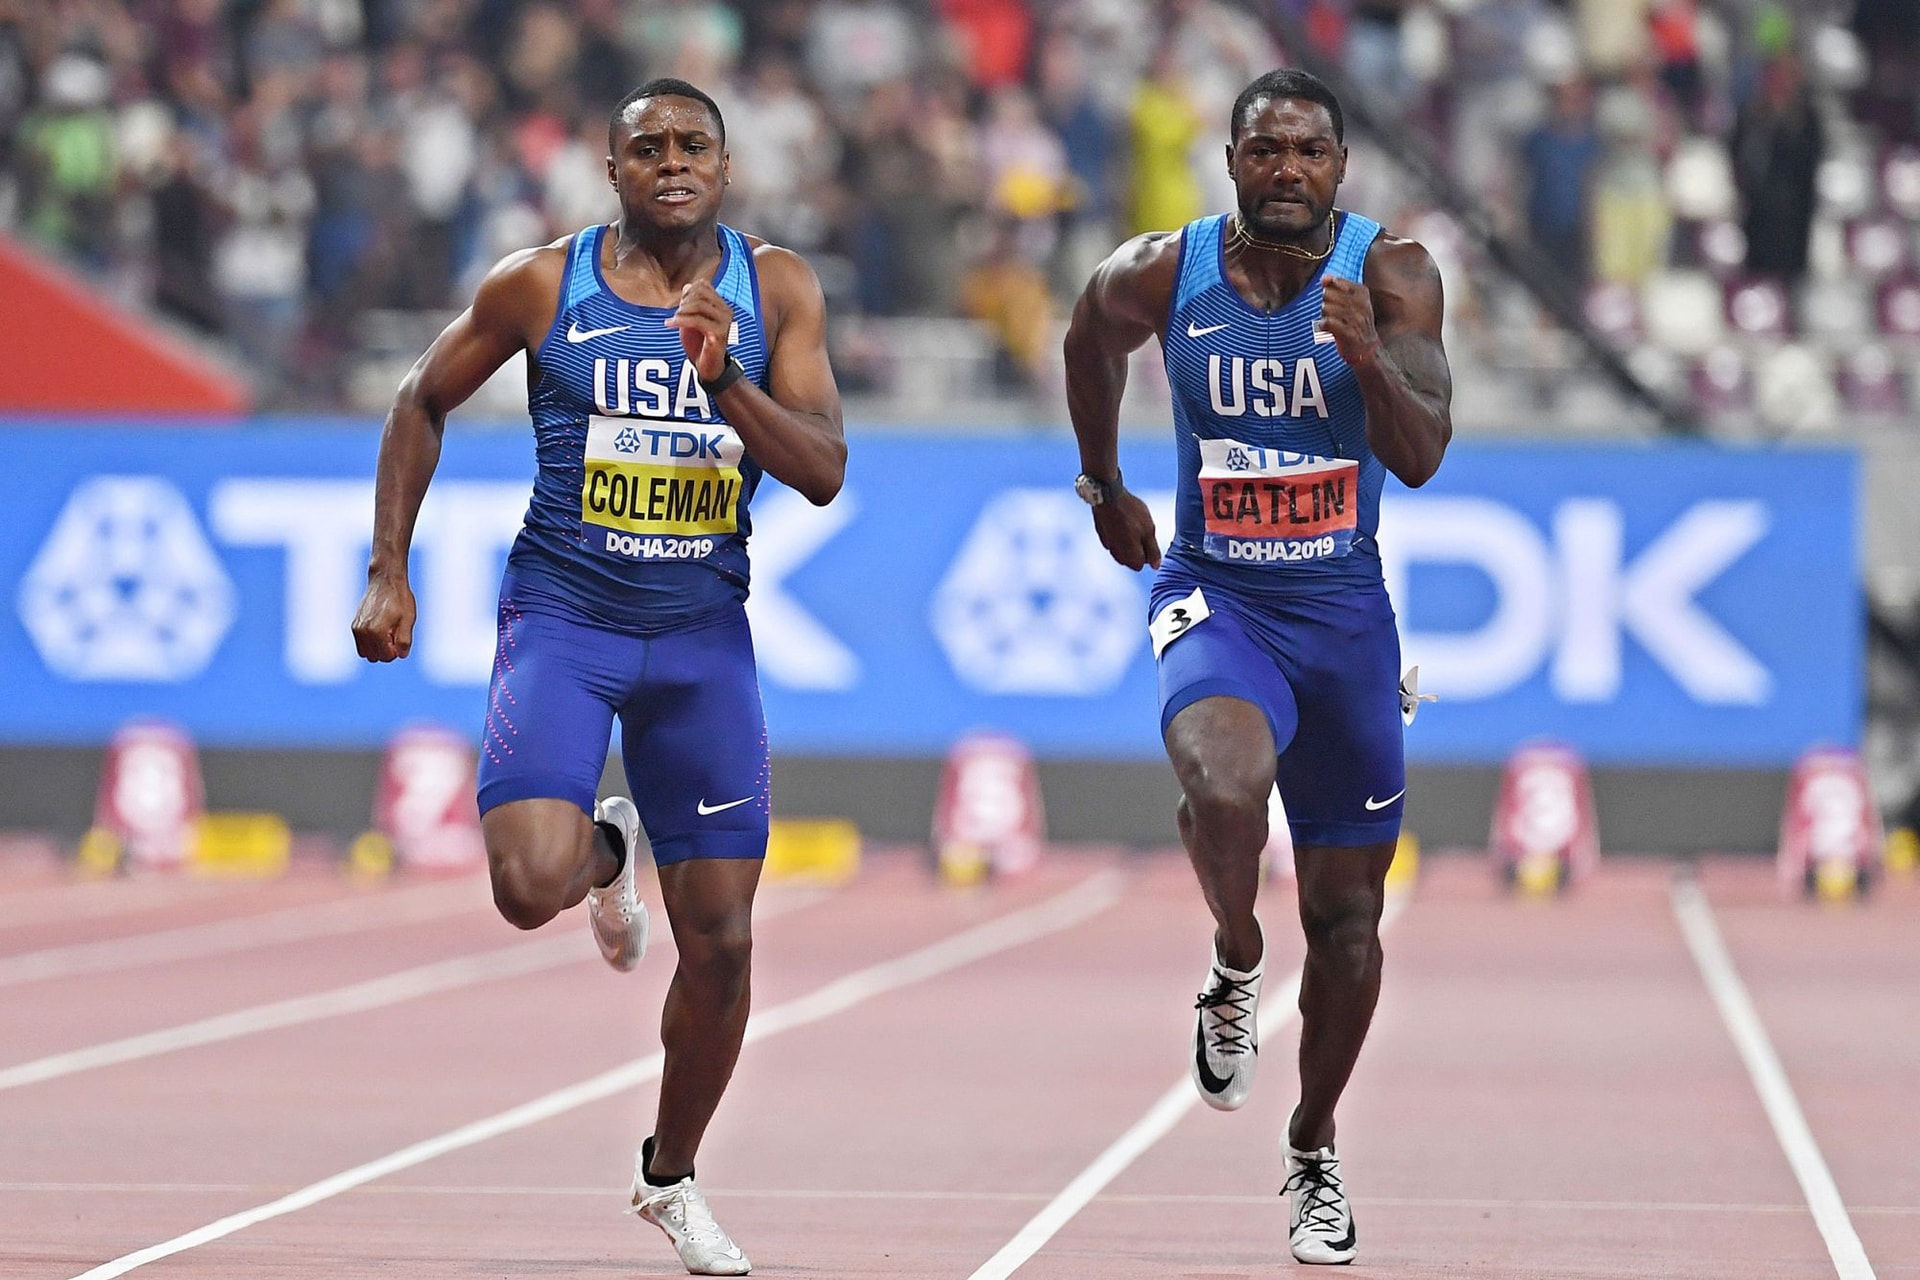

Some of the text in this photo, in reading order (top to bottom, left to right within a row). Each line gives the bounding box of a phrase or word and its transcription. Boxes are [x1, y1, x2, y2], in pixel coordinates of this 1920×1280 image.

[593, 358, 712, 418] USA
[1208, 354, 1329, 419] USA
[641, 429, 725, 460] TDK
[1247, 446, 1336, 470] TD
[588, 469, 734, 522] COLEMAN
[1211, 478, 1345, 525] GATLIN
[605, 532, 714, 559] DOHA2019
[1228, 537, 1335, 561] DOHA2019
[1168, 608, 1192, 635] 3
